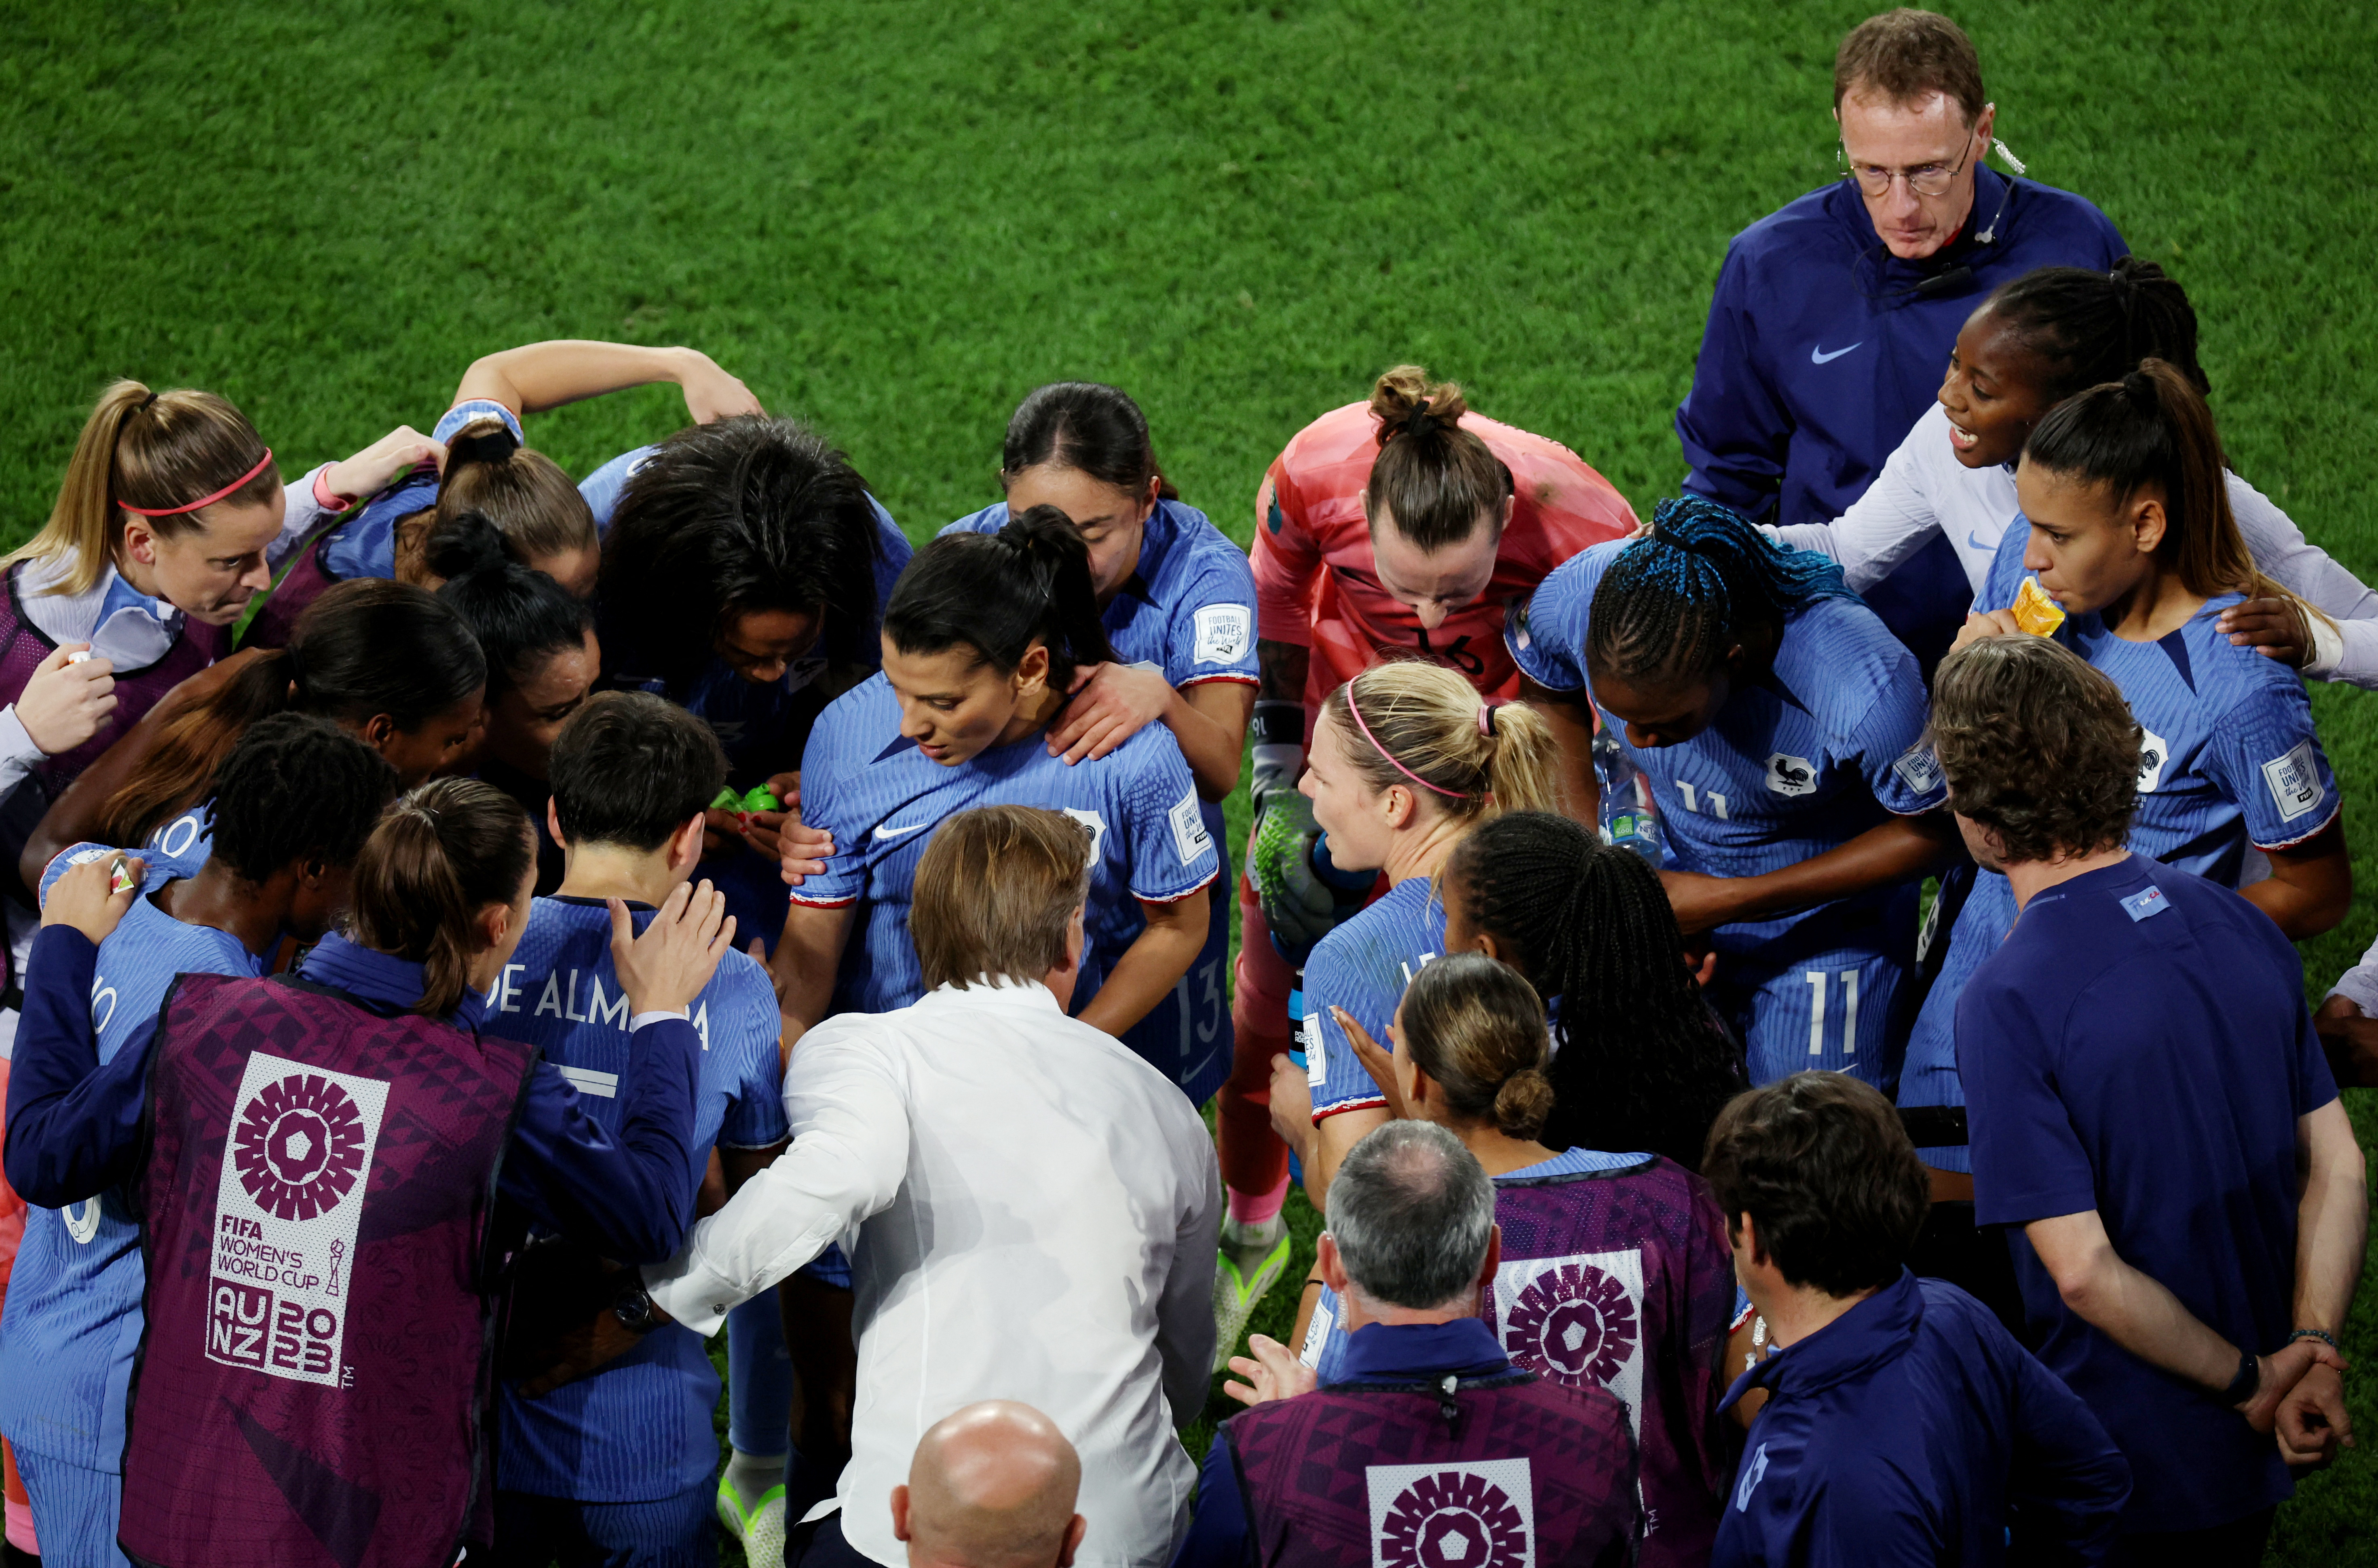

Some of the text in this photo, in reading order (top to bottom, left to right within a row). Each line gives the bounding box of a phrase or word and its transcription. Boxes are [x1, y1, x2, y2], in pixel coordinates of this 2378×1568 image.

[1209, 615, 1242, 625] FOOTBALL
[1210, 624, 1242, 636] UNITES
[1208, 636, 1219, 645] the
[1409, 627, 1485, 675] 16
[1916, 771, 1928, 779] the
[2281, 761, 2306, 787] UNITES
[1676, 779, 1729, 820] 11
[2284, 787, 2298, 797] the
[1184, 809, 1200, 829] UNIT
[1185, 829, 1196, 840] the
[1176, 956, 1220, 1057] 13
[1806, 969, 1860, 1055] 11
[221, 1214, 262, 1241] FIFA
[220, 1235, 303, 1269] WOMEN'S
[218, 1253, 319, 1290] WORLD CUP
[214, 1285, 267, 1325] AU
[277, 1300, 337, 1340] 20
[212, 1318, 263, 1361] NZ
[272, 1333, 333, 1374] 23
[341, 1365, 355, 1389] TM
